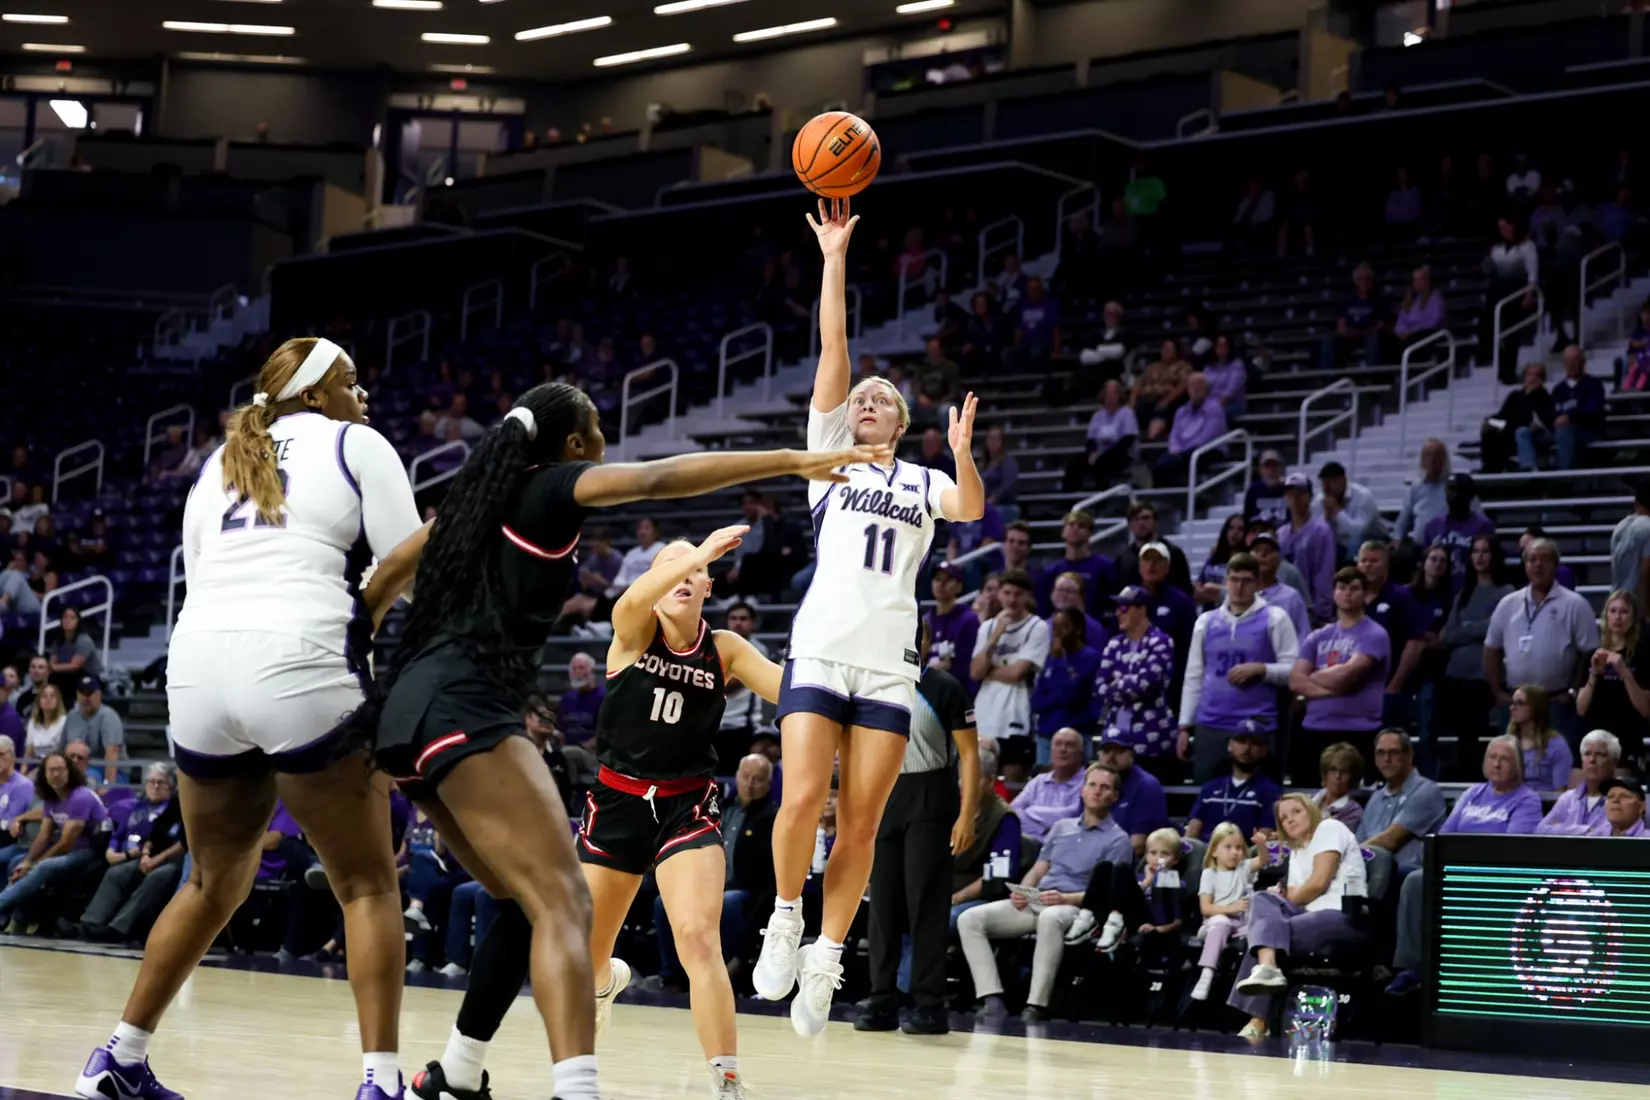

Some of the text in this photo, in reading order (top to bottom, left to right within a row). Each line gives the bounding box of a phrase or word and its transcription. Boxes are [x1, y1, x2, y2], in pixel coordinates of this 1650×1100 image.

[840, 486, 923, 528] Wildcats
[863, 522, 897, 576] 11
[634, 653, 715, 690] COYOTES
[650, 687, 684, 724] 10
